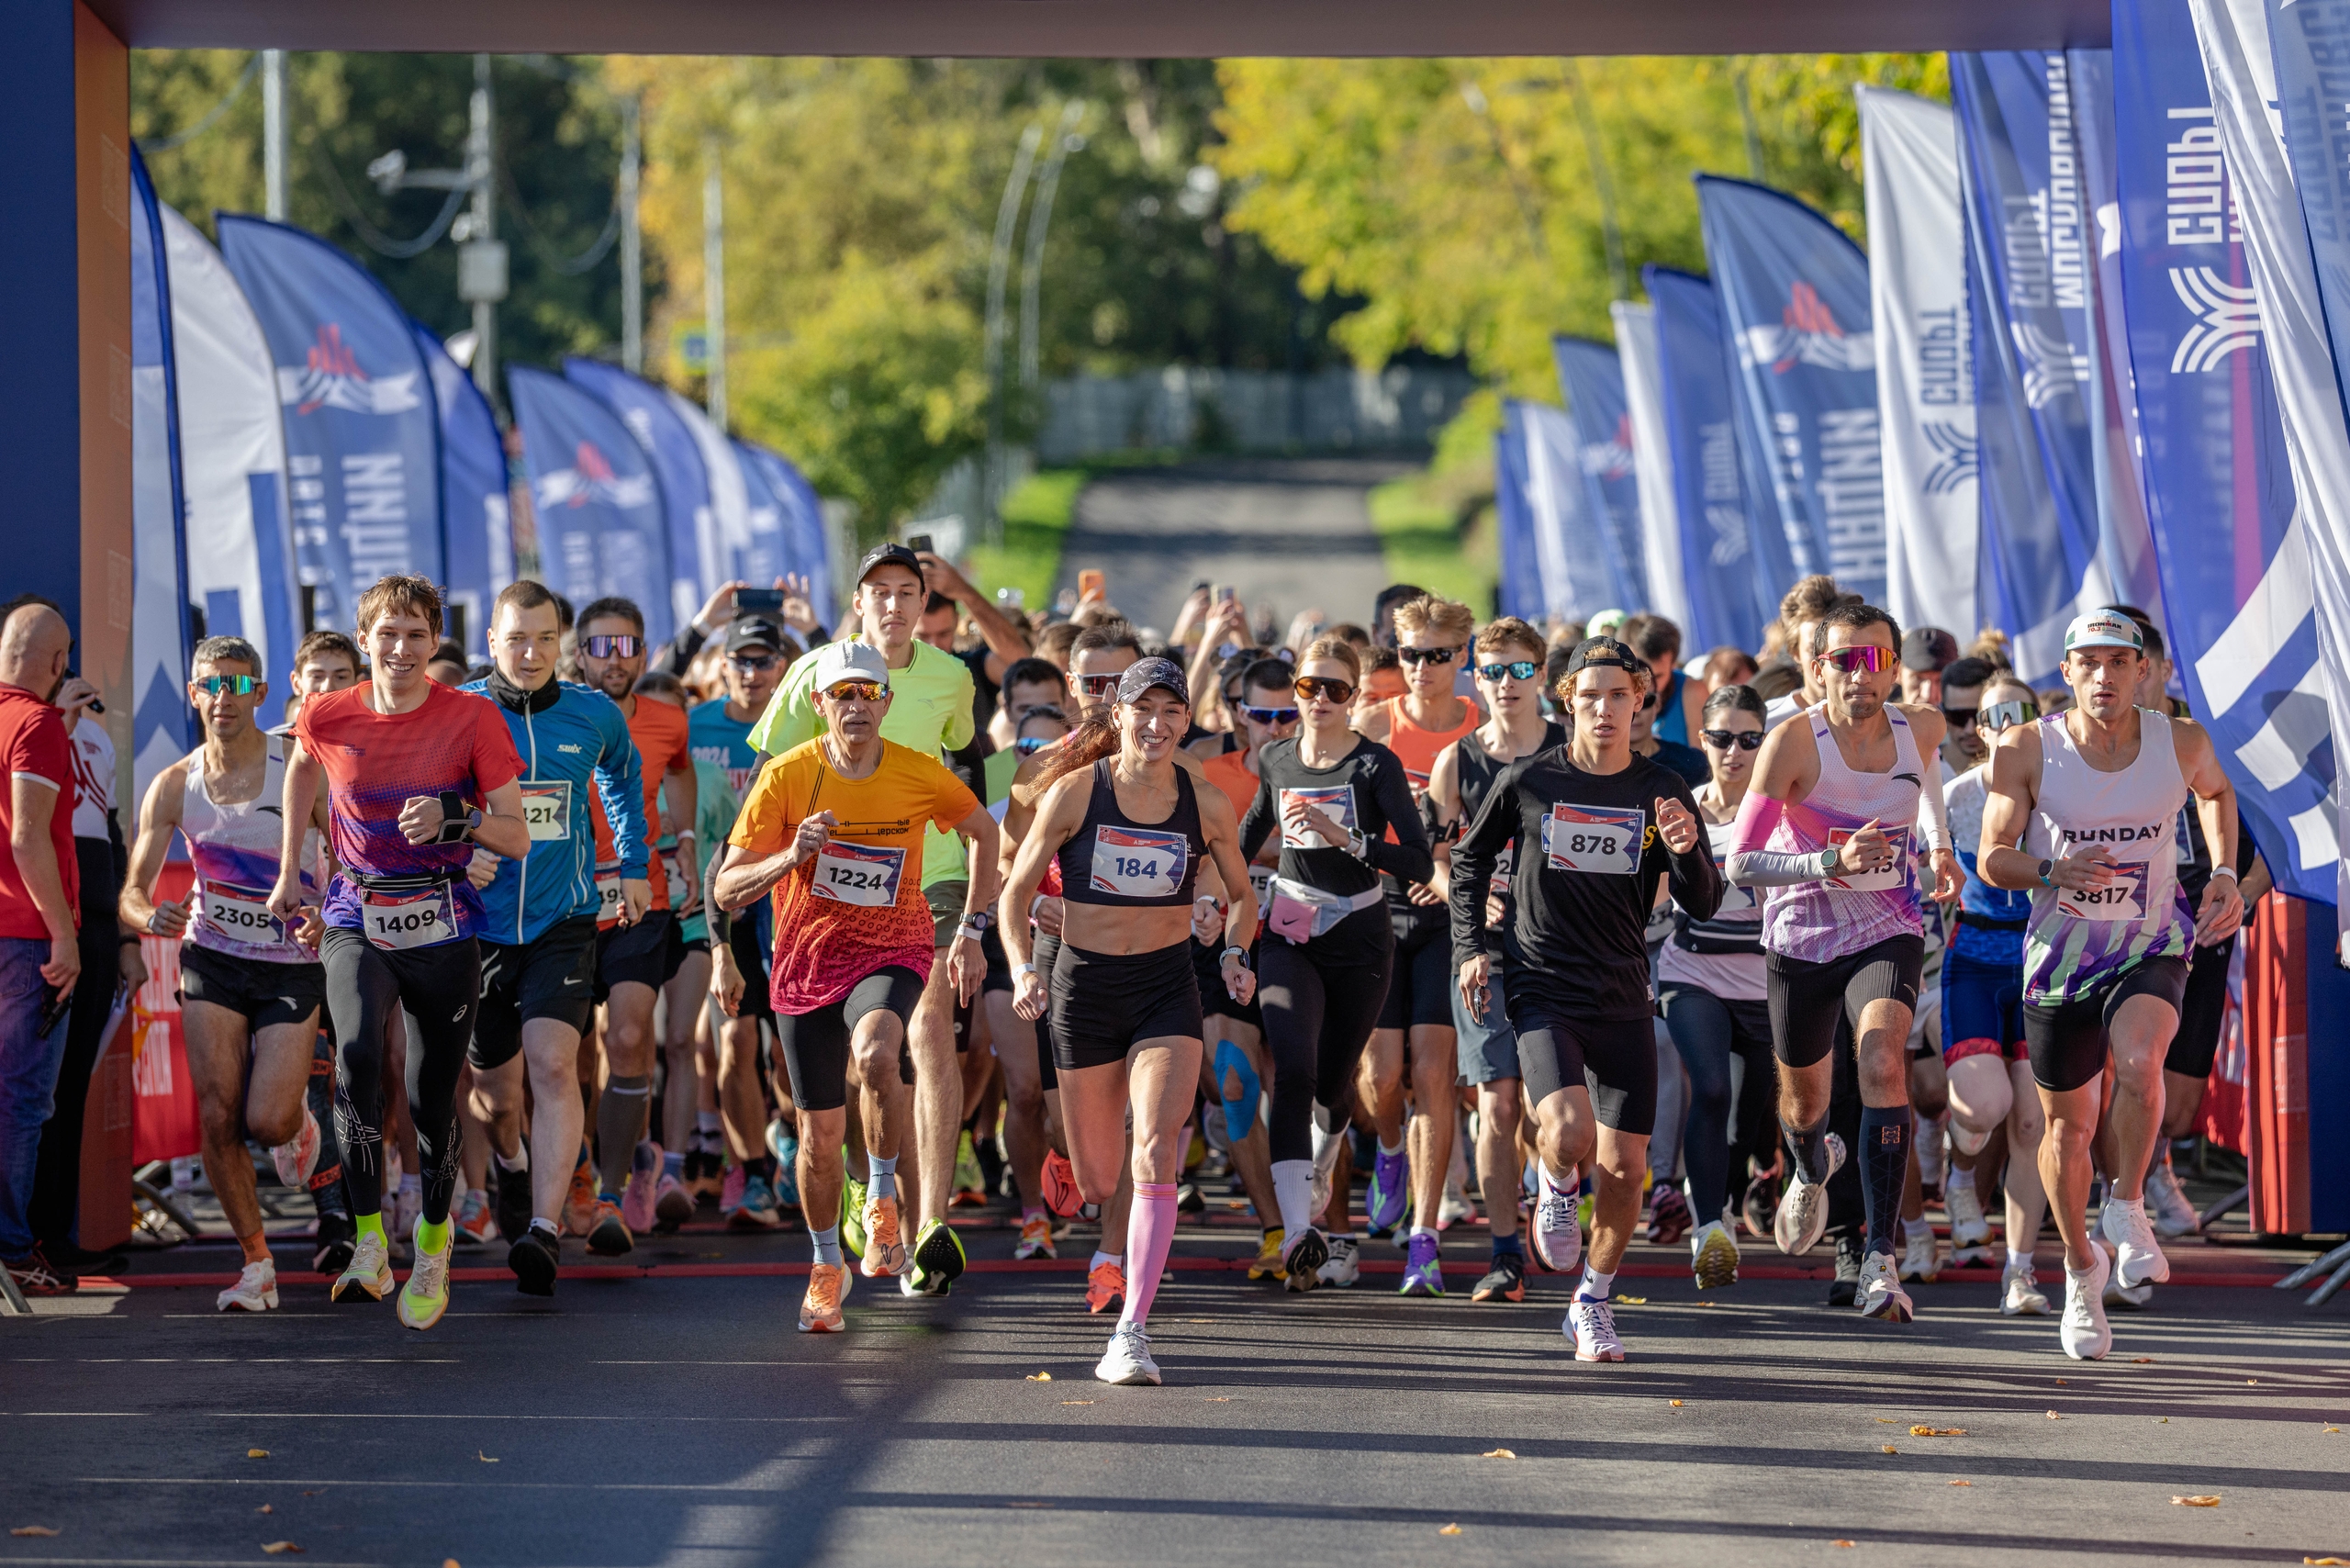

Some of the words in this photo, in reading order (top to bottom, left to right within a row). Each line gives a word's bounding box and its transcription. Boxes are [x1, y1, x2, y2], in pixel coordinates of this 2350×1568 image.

[2087, 621, 2122, 630] IRONMAN
[2063, 823, 2162, 844] RUNDAY
[1571, 834, 1617, 855] 878
[829, 867, 882, 890] 1224
[1115, 857, 1158, 879] 184
[2072, 887, 2129, 904] 3817
[213, 904, 270, 929] 2305
[375, 909, 436, 934] 1409
